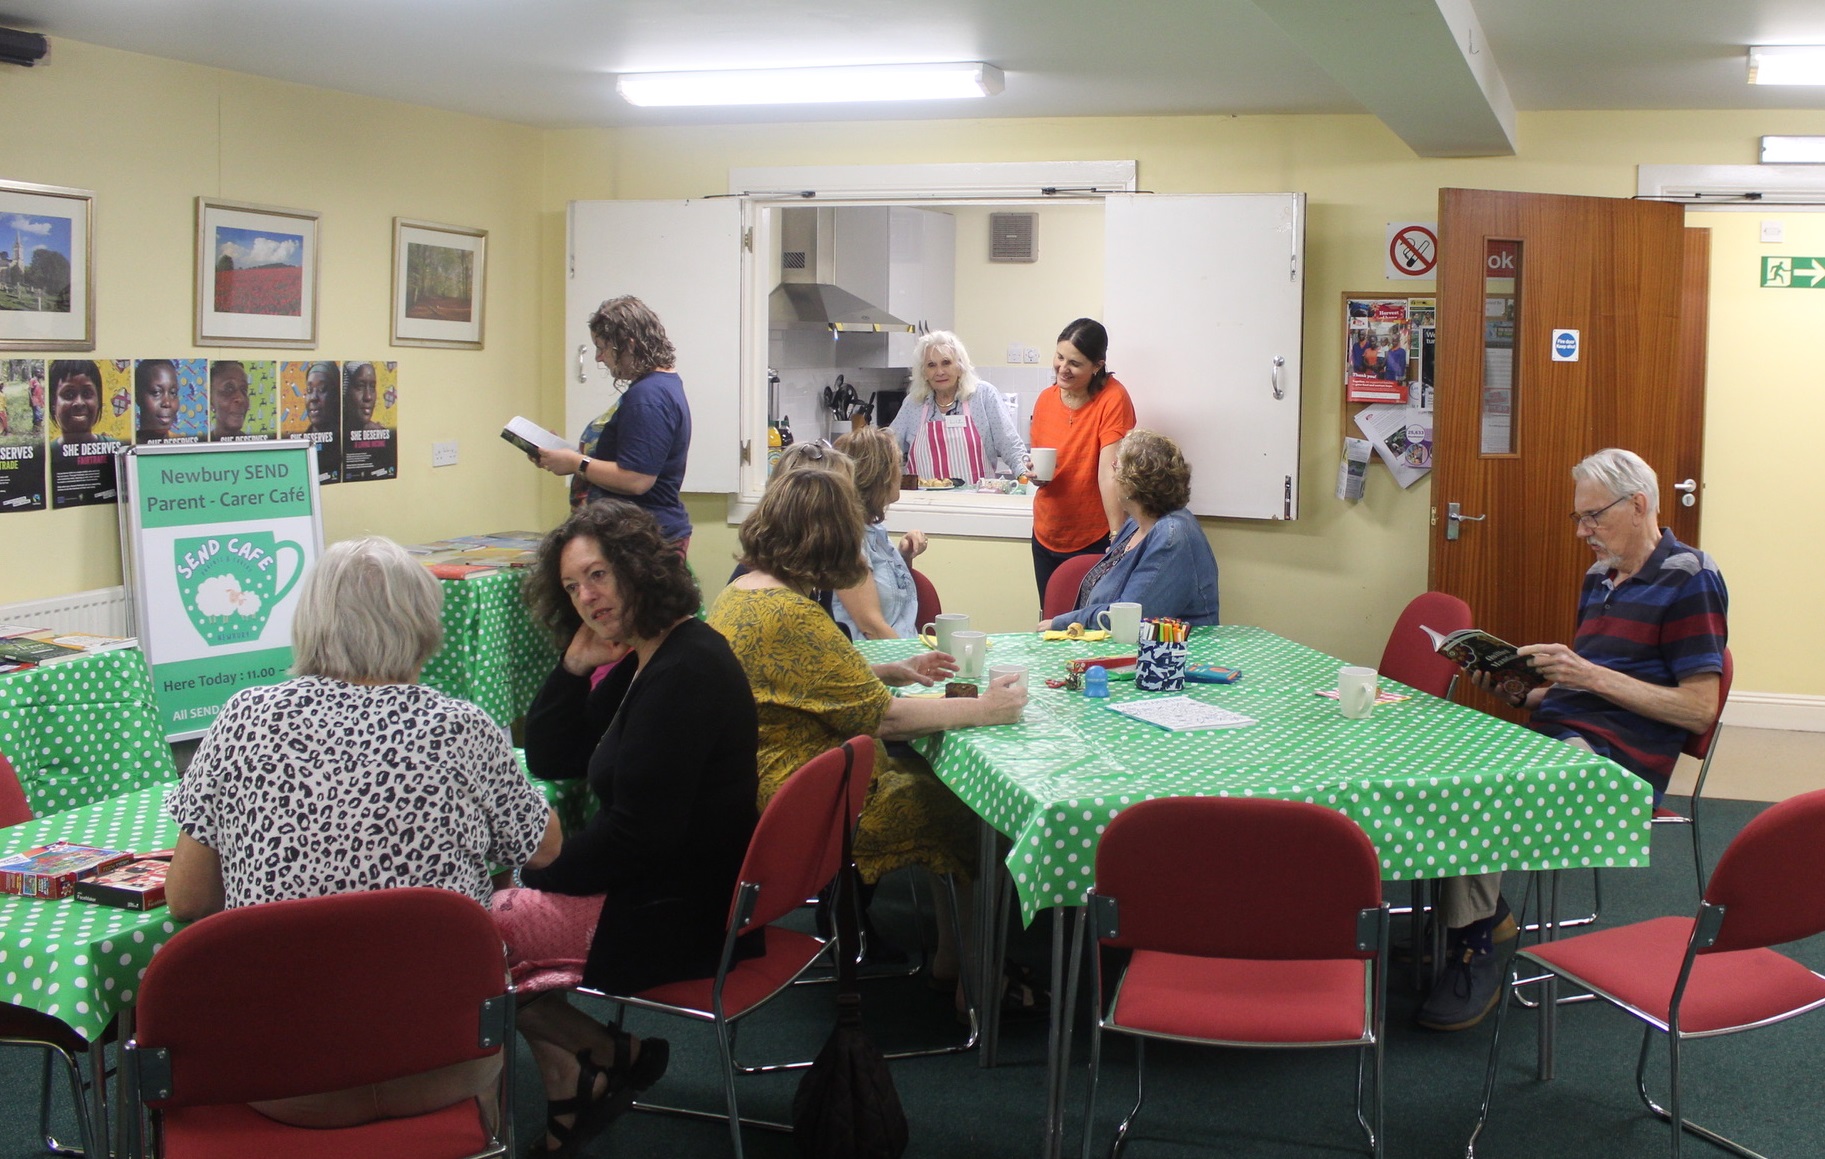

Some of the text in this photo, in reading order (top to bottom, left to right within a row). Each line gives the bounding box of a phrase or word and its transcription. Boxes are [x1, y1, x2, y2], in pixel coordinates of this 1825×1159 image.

[1488, 251, 1514, 269] ok
[350, 429, 391, 441] SHE DESERVES
[62, 441, 121, 457] SHE DESERVES
[161, 463, 289, 485] Newbury SEND
[147, 495, 206, 512] Parent
[220, 490, 265, 507] Carer
[269, 486, 306, 504] Café
[177, 538, 274, 579] SEND CAFE
[163, 679, 196, 692] Here
[198, 672, 237, 687] Today
[247, 667, 276, 680] 11.00
[172, 709, 188, 721] All
[190, 705, 220, 719] SEND
